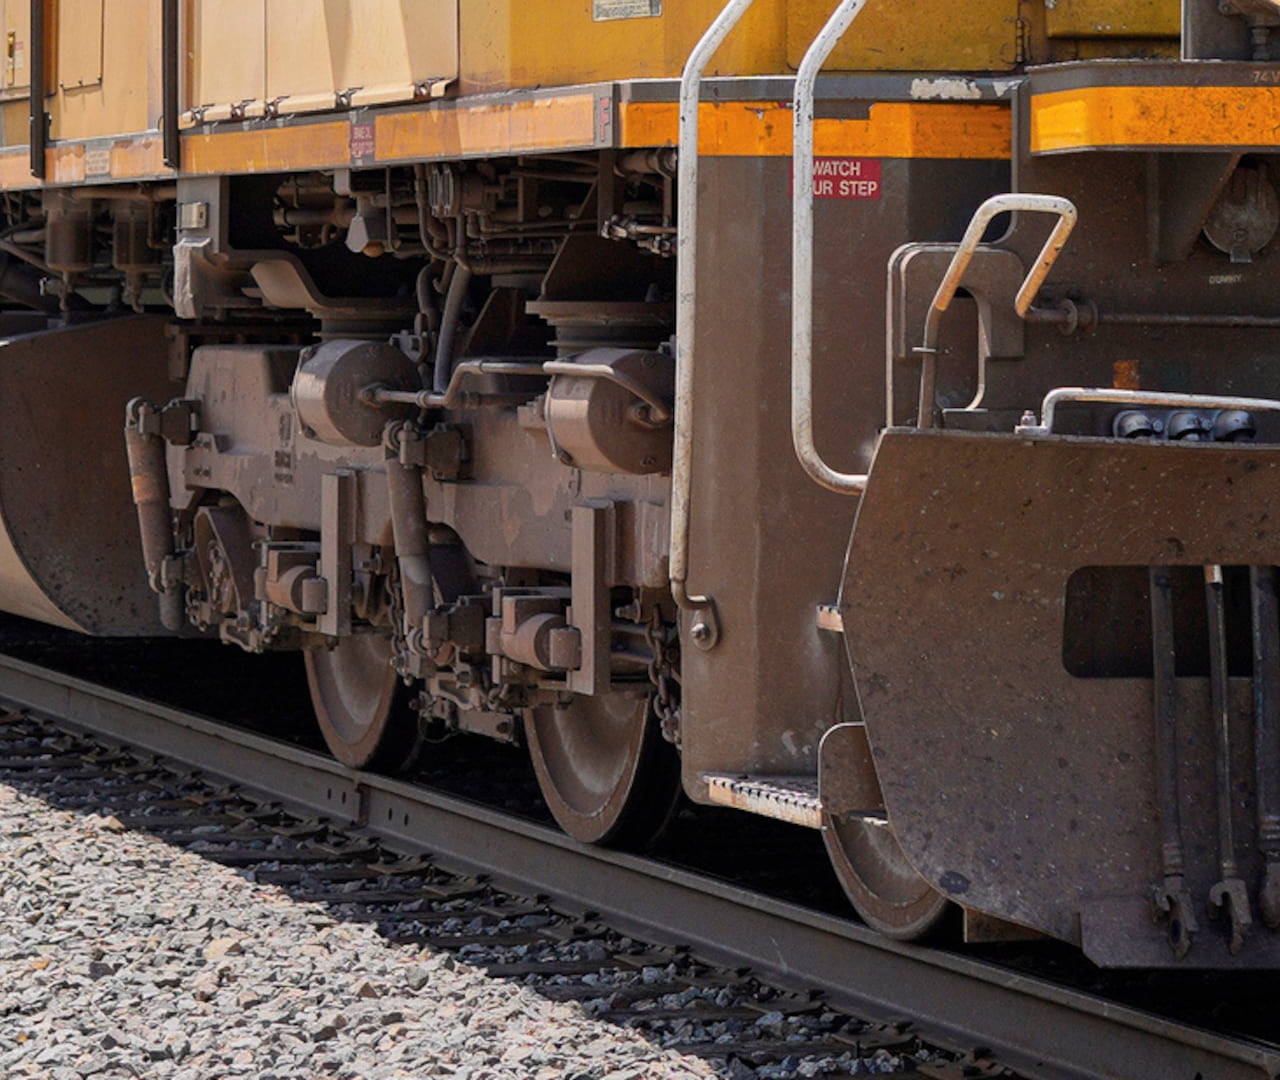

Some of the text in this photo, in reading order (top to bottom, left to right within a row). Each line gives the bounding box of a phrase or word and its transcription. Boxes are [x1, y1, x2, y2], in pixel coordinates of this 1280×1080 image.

[1252, 71, 1268, 83] 74
[813, 161, 861, 176] WATCH
[839, 180, 878, 196] STEP
